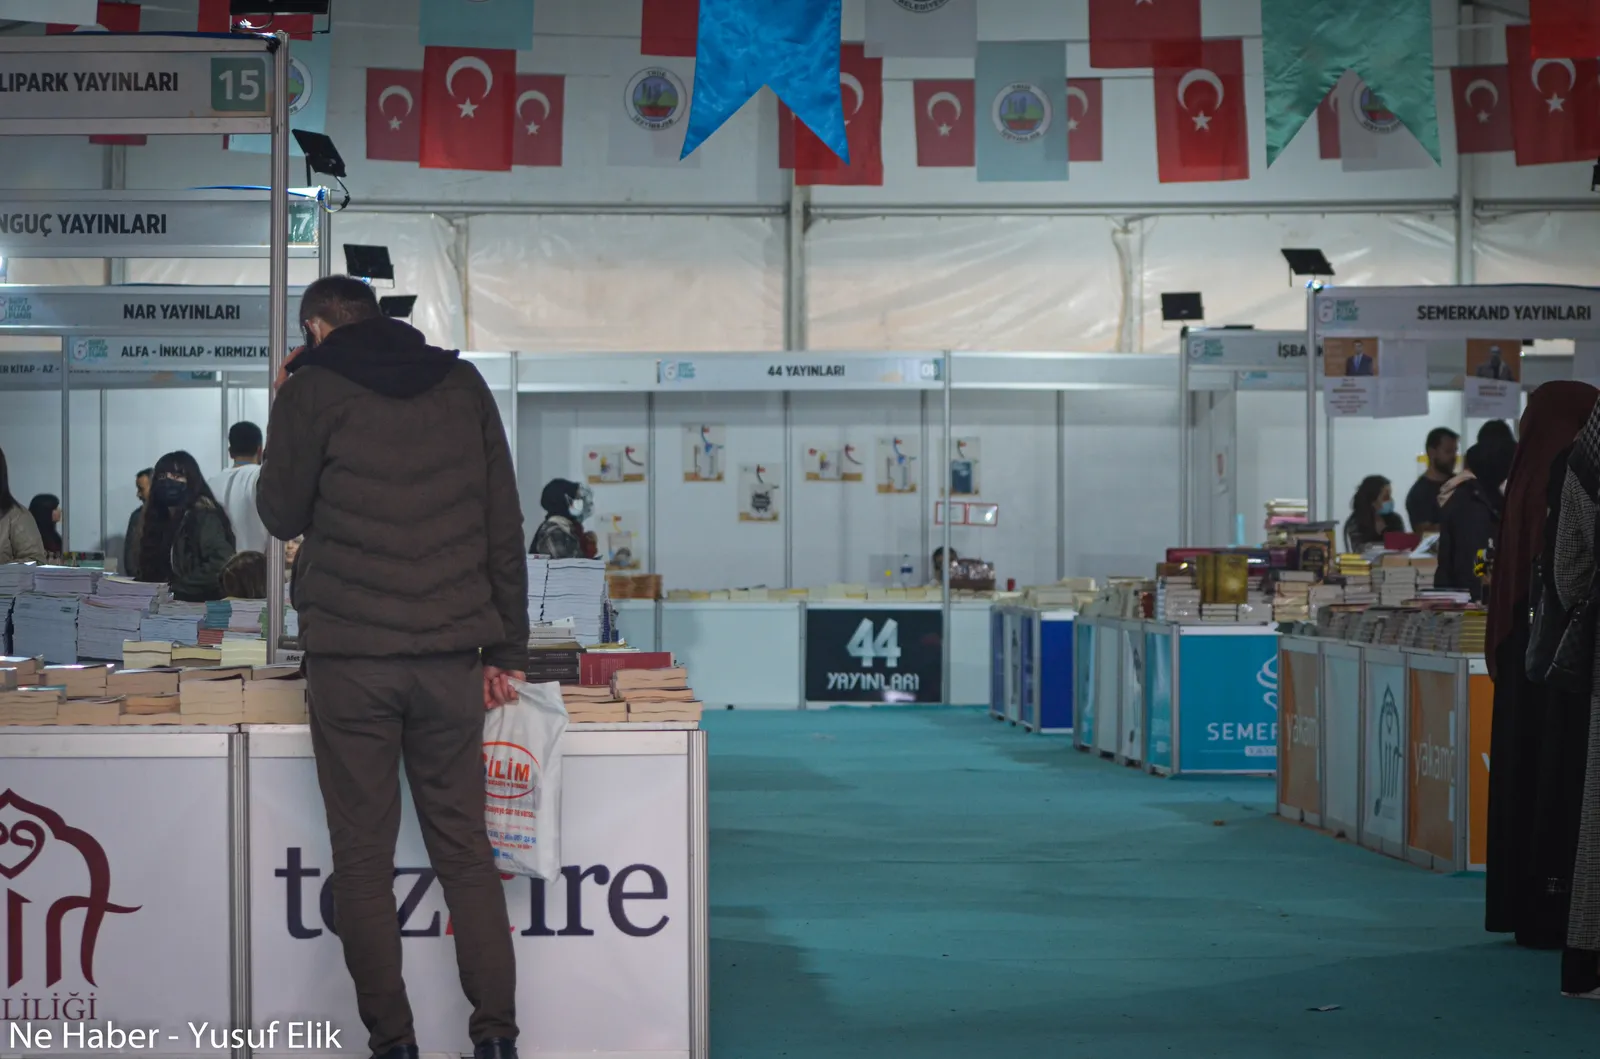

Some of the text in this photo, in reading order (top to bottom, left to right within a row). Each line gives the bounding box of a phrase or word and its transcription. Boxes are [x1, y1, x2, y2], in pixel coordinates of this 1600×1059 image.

[0, 72, 179, 92] LIPARK YAYINLARI
[218, 70, 260, 101] 15
[0, 213, 167, 238] NGUÇ YAYINLARI
[123, 304, 241, 320] NAR YAYINLARI
[1416, 304, 1592, 321] SEMERKAND YAYINLARI
[121, 345, 149, 358] ALFA
[159, 343, 204, 358] İNKILAP
[214, 345, 257, 358] KIRMIZI
[10, 364, 35, 374] KİTAP
[42, 364, 54, 374] AZ
[767, 365, 845, 377] 44 YAYINLARI
[846, 617, 902, 668] 44
[826, 672, 920, 691] YAYINLARI
[481, 753, 530, 783] İLİM
[274, 846, 671, 940] tzire
[0, 991, 98, 1020] LİLİĞİ
